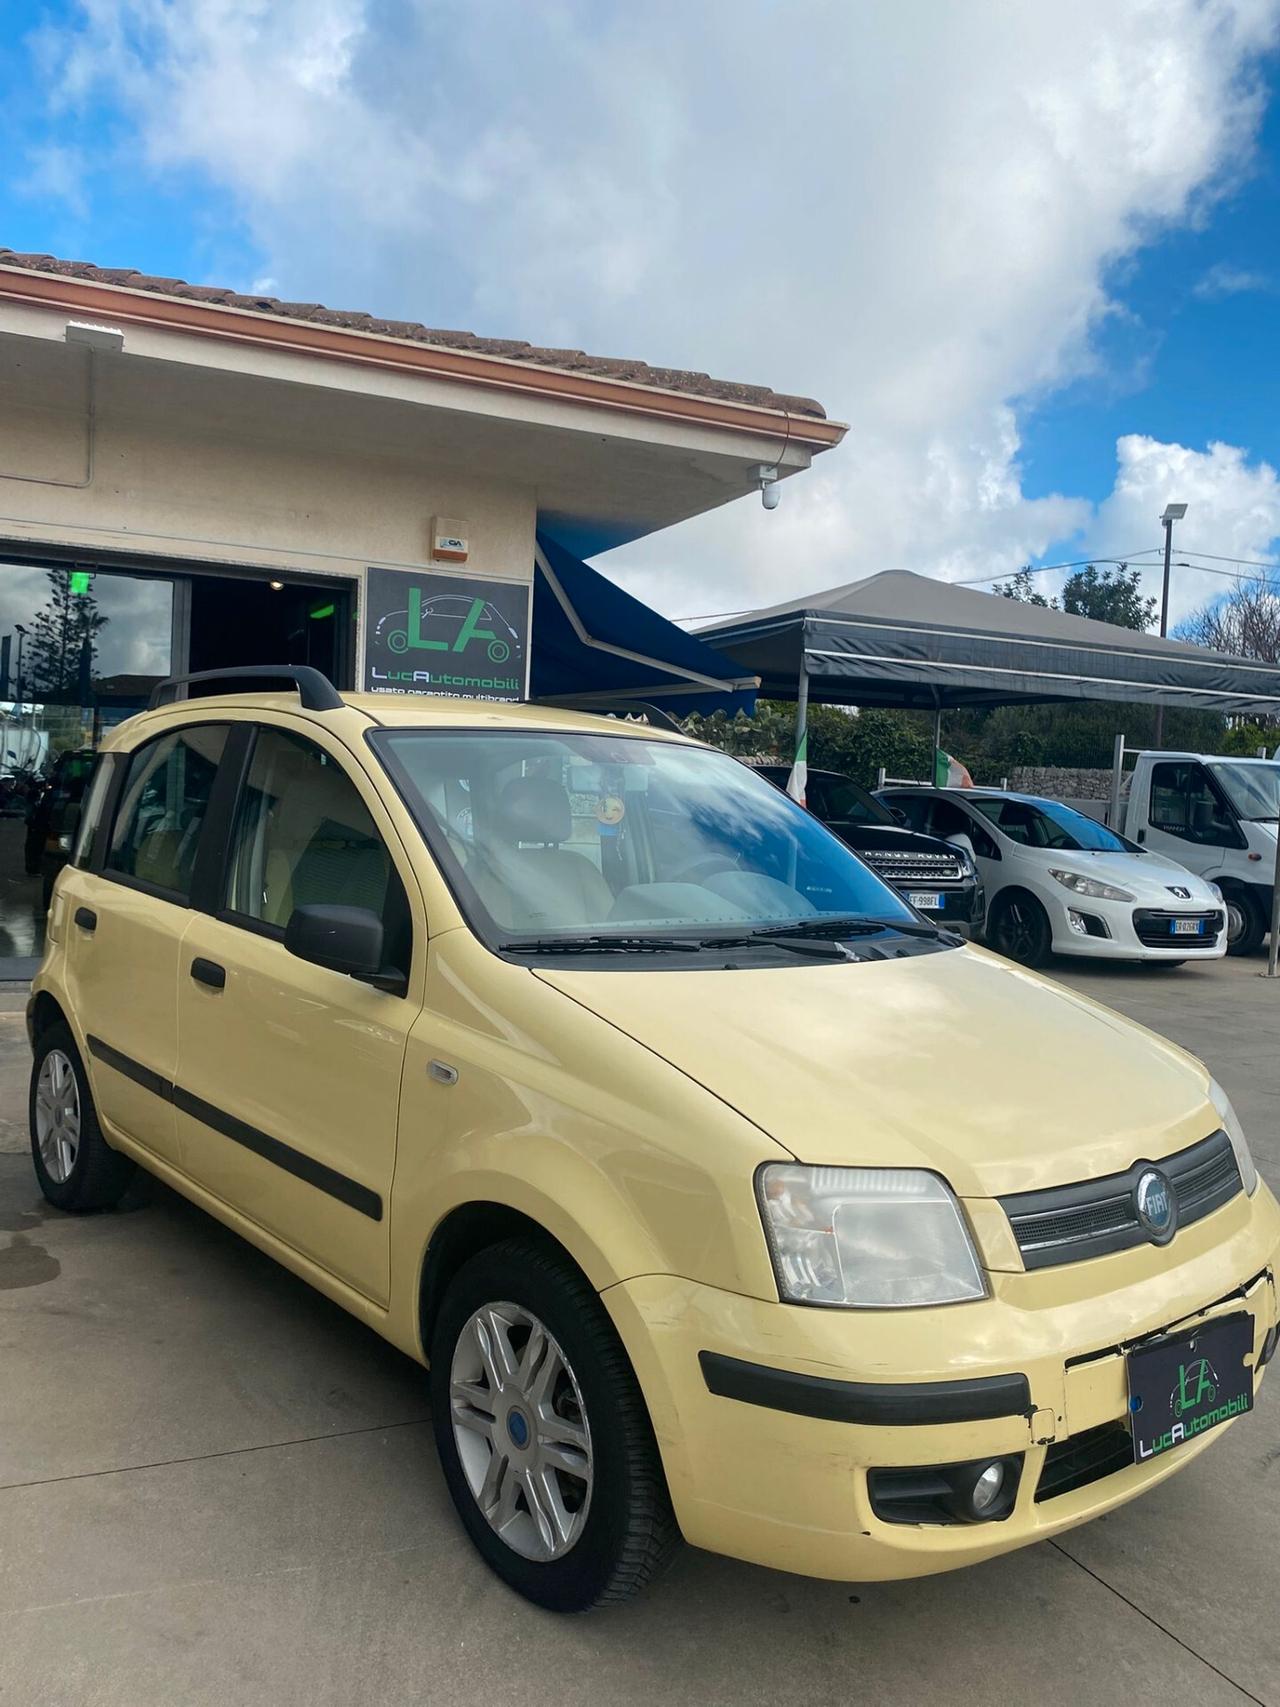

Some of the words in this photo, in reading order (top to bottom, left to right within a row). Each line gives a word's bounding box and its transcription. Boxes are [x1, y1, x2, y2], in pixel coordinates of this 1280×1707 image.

[371, 666, 519, 690] LucAutomobili
[1145, 1191, 1168, 1217] FIAT
[1139, 1392, 1248, 1458] LucAutomobili
